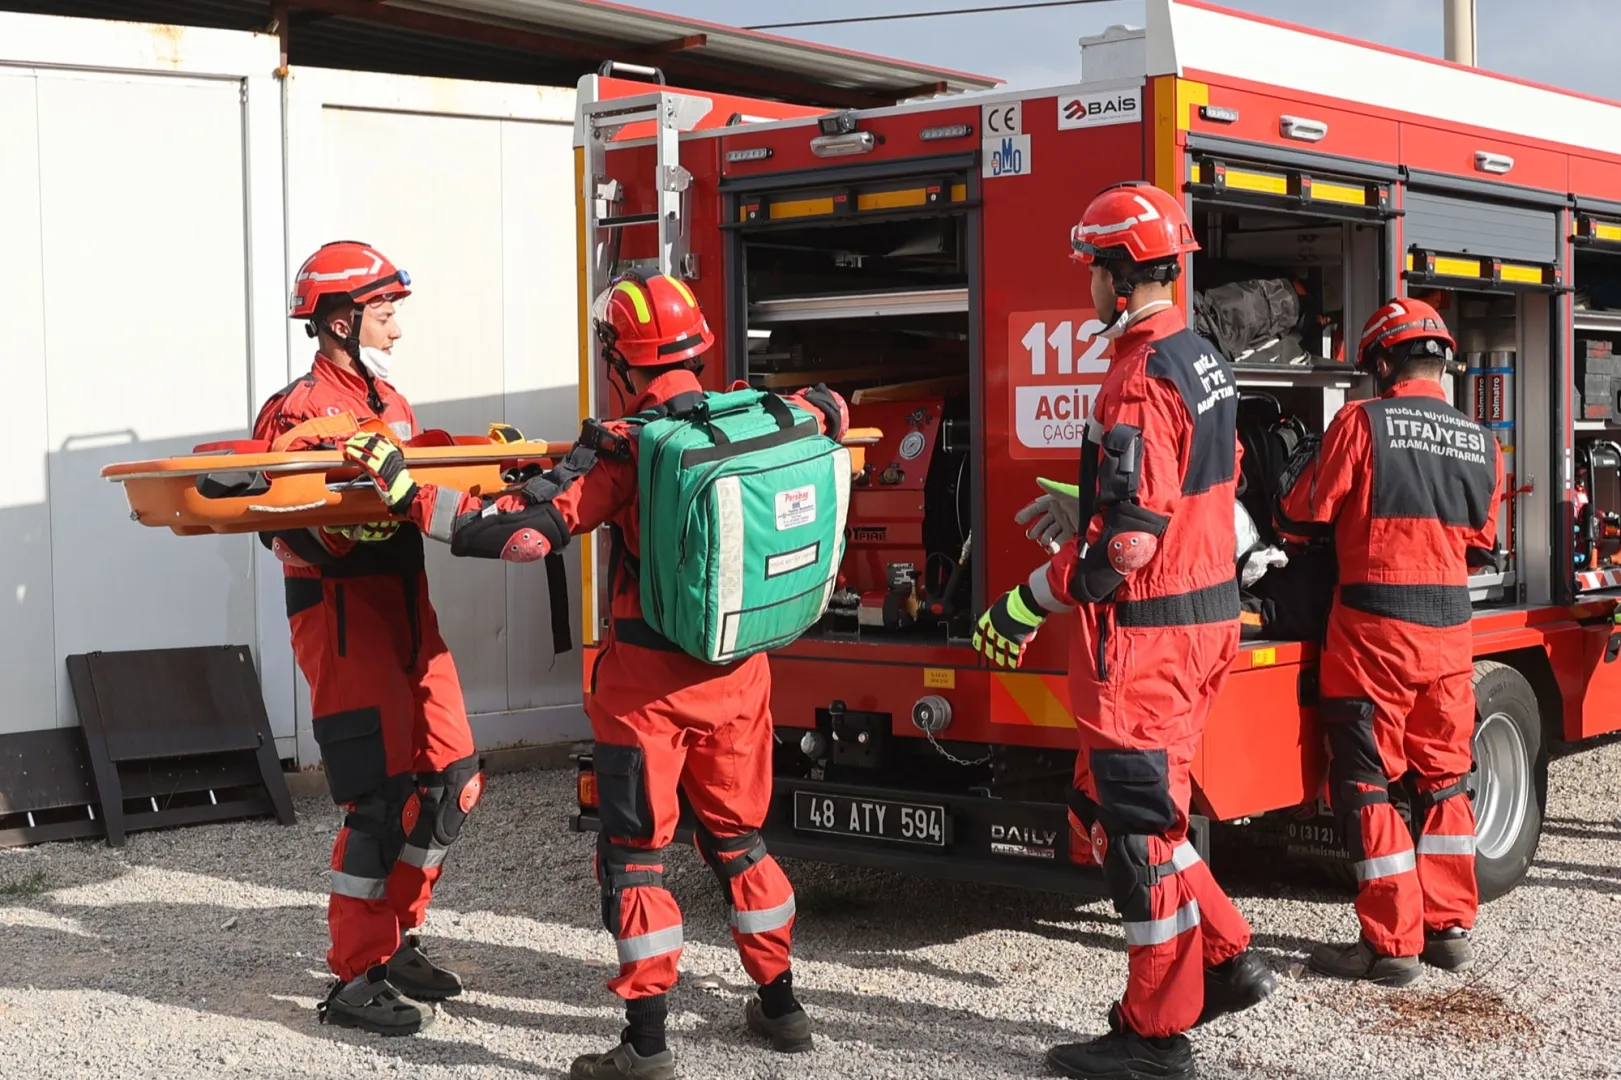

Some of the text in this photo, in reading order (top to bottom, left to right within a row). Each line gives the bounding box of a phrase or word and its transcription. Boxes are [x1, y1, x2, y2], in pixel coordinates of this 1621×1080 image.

[1088, 95, 1136, 115] BAİS
[988, 107, 1015, 132] CE
[992, 137, 1022, 176] DMO
[1021, 319, 1111, 375] 112
[1492, 377, 1500, 418] holmatro
[1384, 407, 1423, 417] MUĞLA
[1043, 421, 1084, 444] ÇAĞR
[1385, 416, 1486, 453] İTFAİYESİ
[1389, 439, 1486, 465] ARAMA KURTARMA
[809, 798, 941, 841] 48 ATY 594
[991, 824, 1057, 845] DAILY
[1300, 825, 1334, 844] (312)
